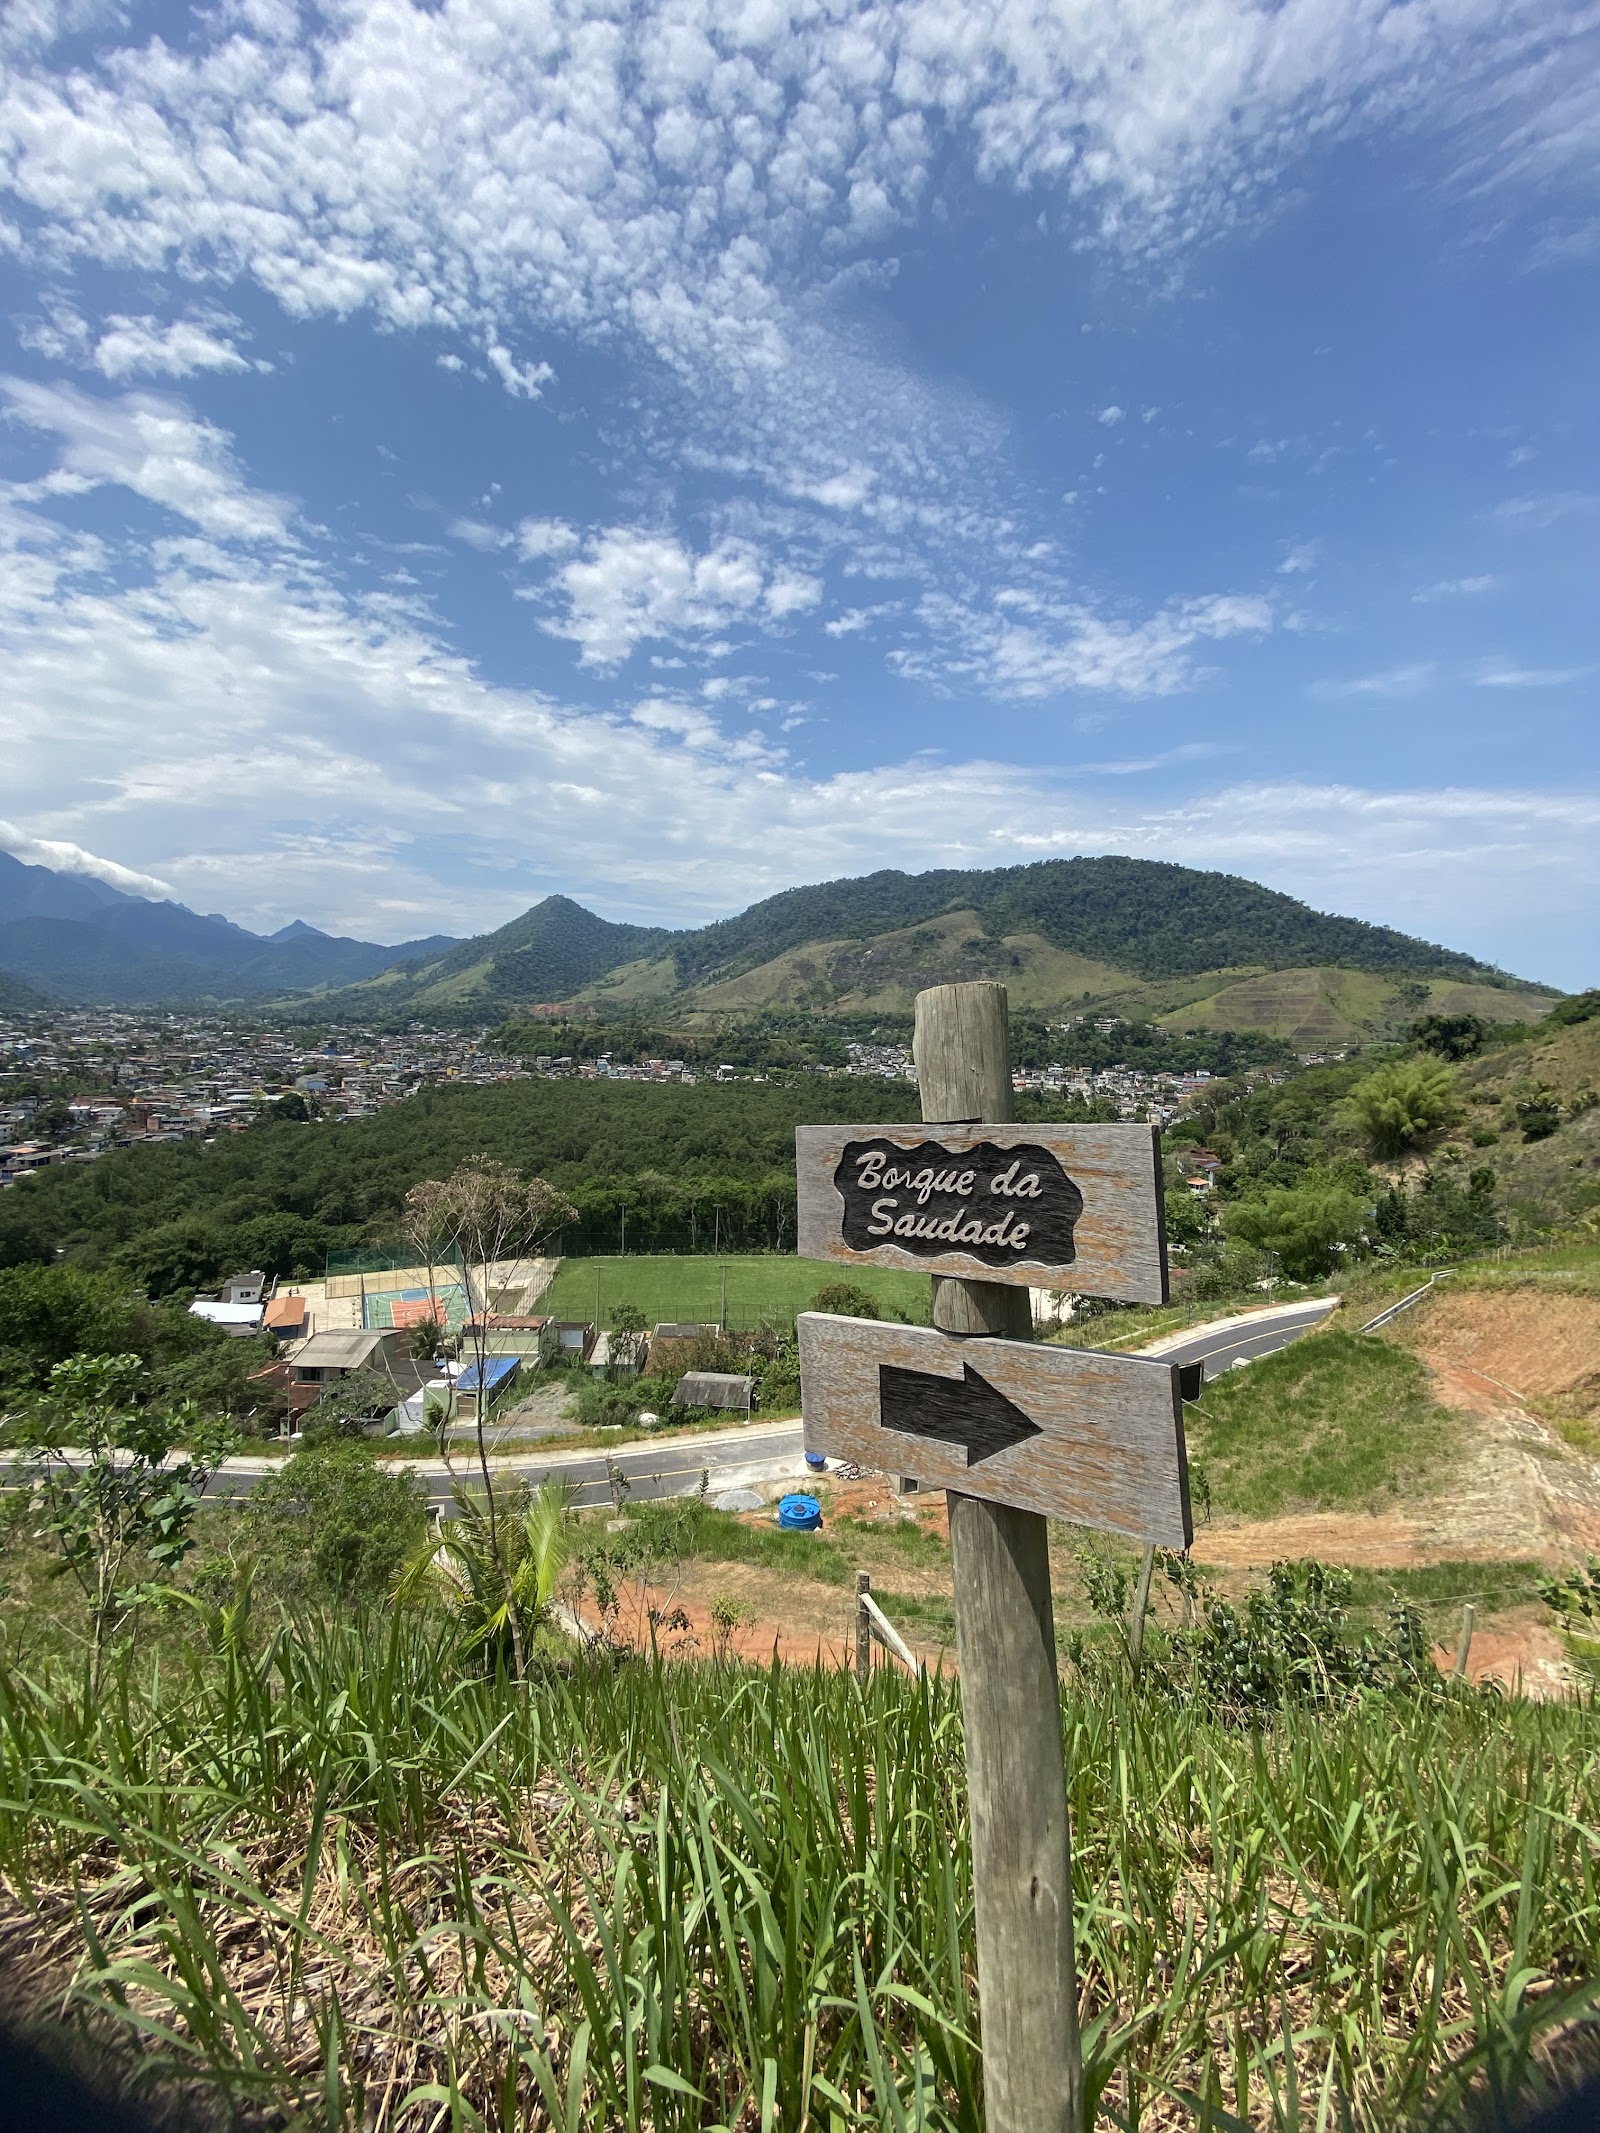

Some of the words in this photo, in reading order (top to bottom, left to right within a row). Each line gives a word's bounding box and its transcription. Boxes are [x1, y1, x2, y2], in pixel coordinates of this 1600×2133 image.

[856, 1151, 975, 1204] Bosque
[990, 1160, 1042, 1198] da
[867, 1198, 1031, 1249] Saudade
